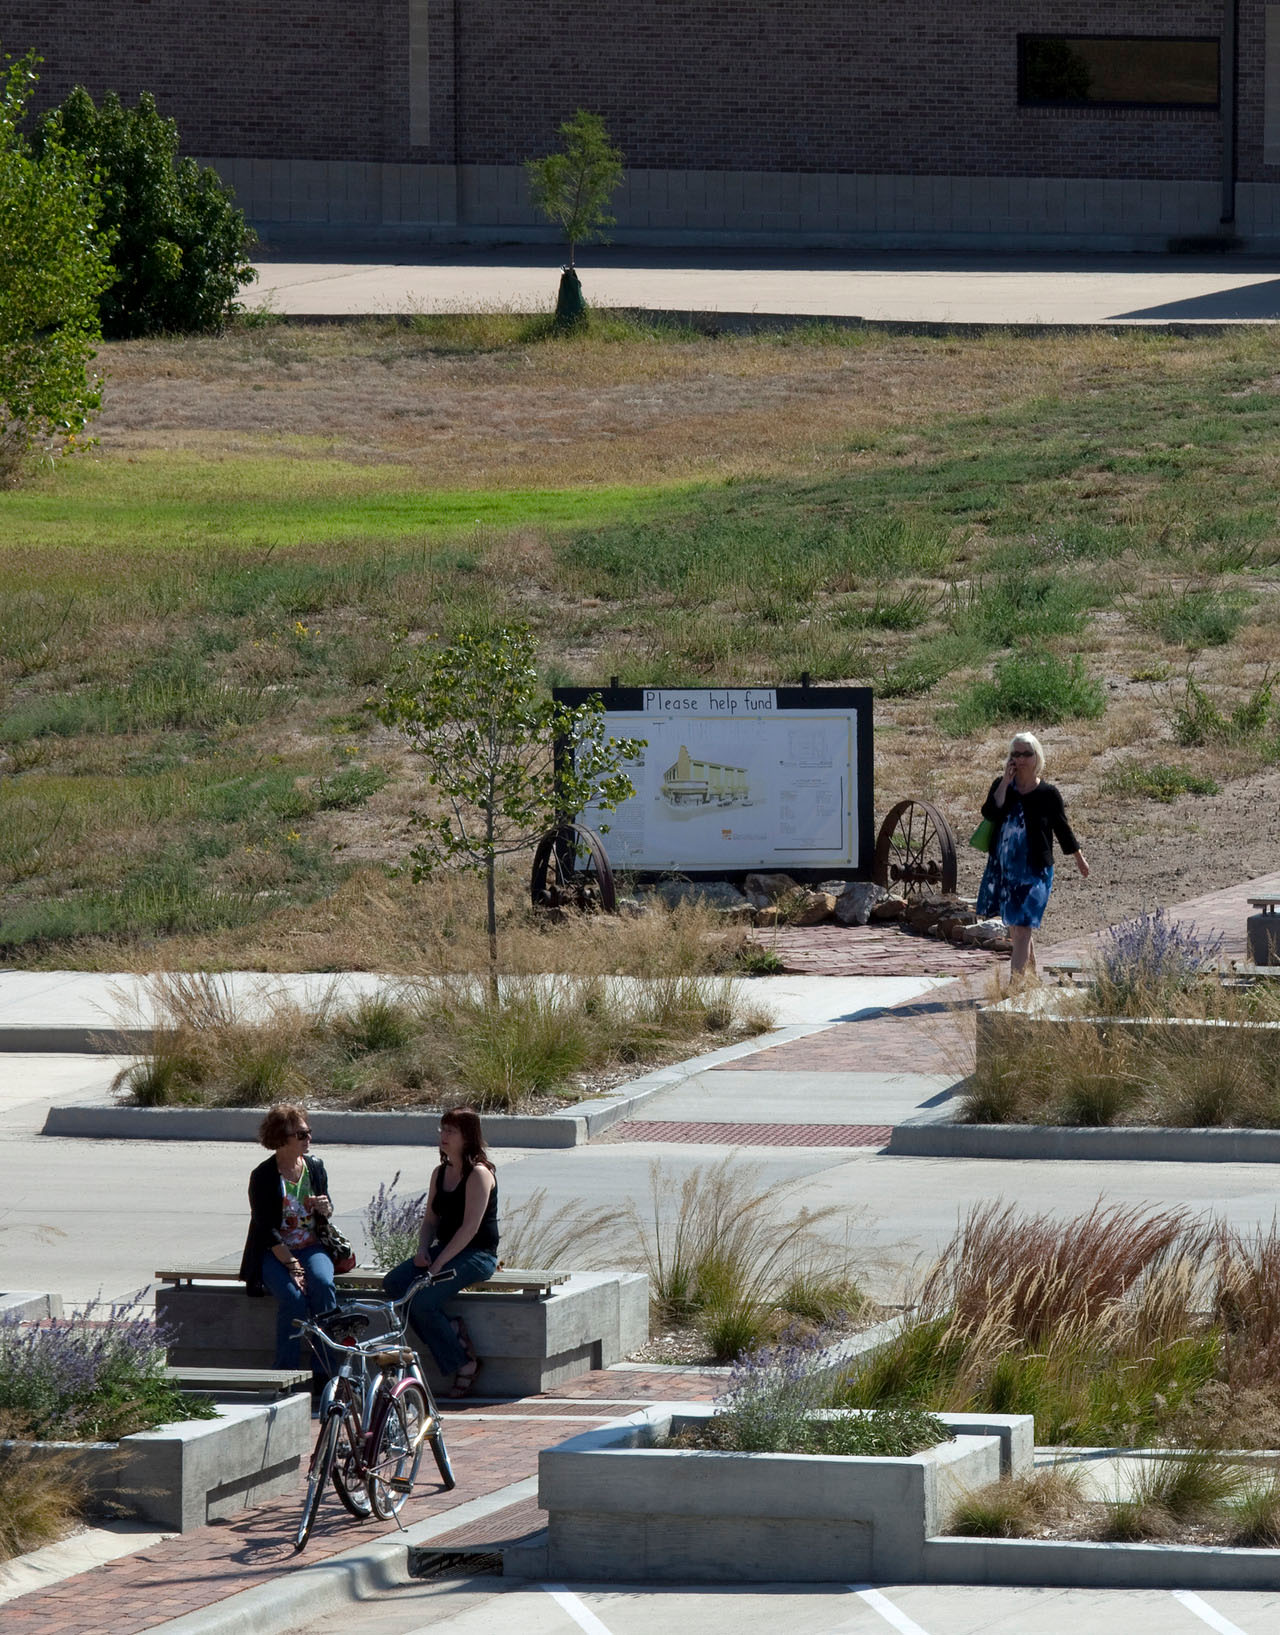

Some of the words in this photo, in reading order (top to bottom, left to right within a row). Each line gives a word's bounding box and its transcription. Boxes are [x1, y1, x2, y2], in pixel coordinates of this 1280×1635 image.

[646, 692, 698, 711] Please
[710, 692, 738, 715] help
[744, 691, 772, 710] fund
